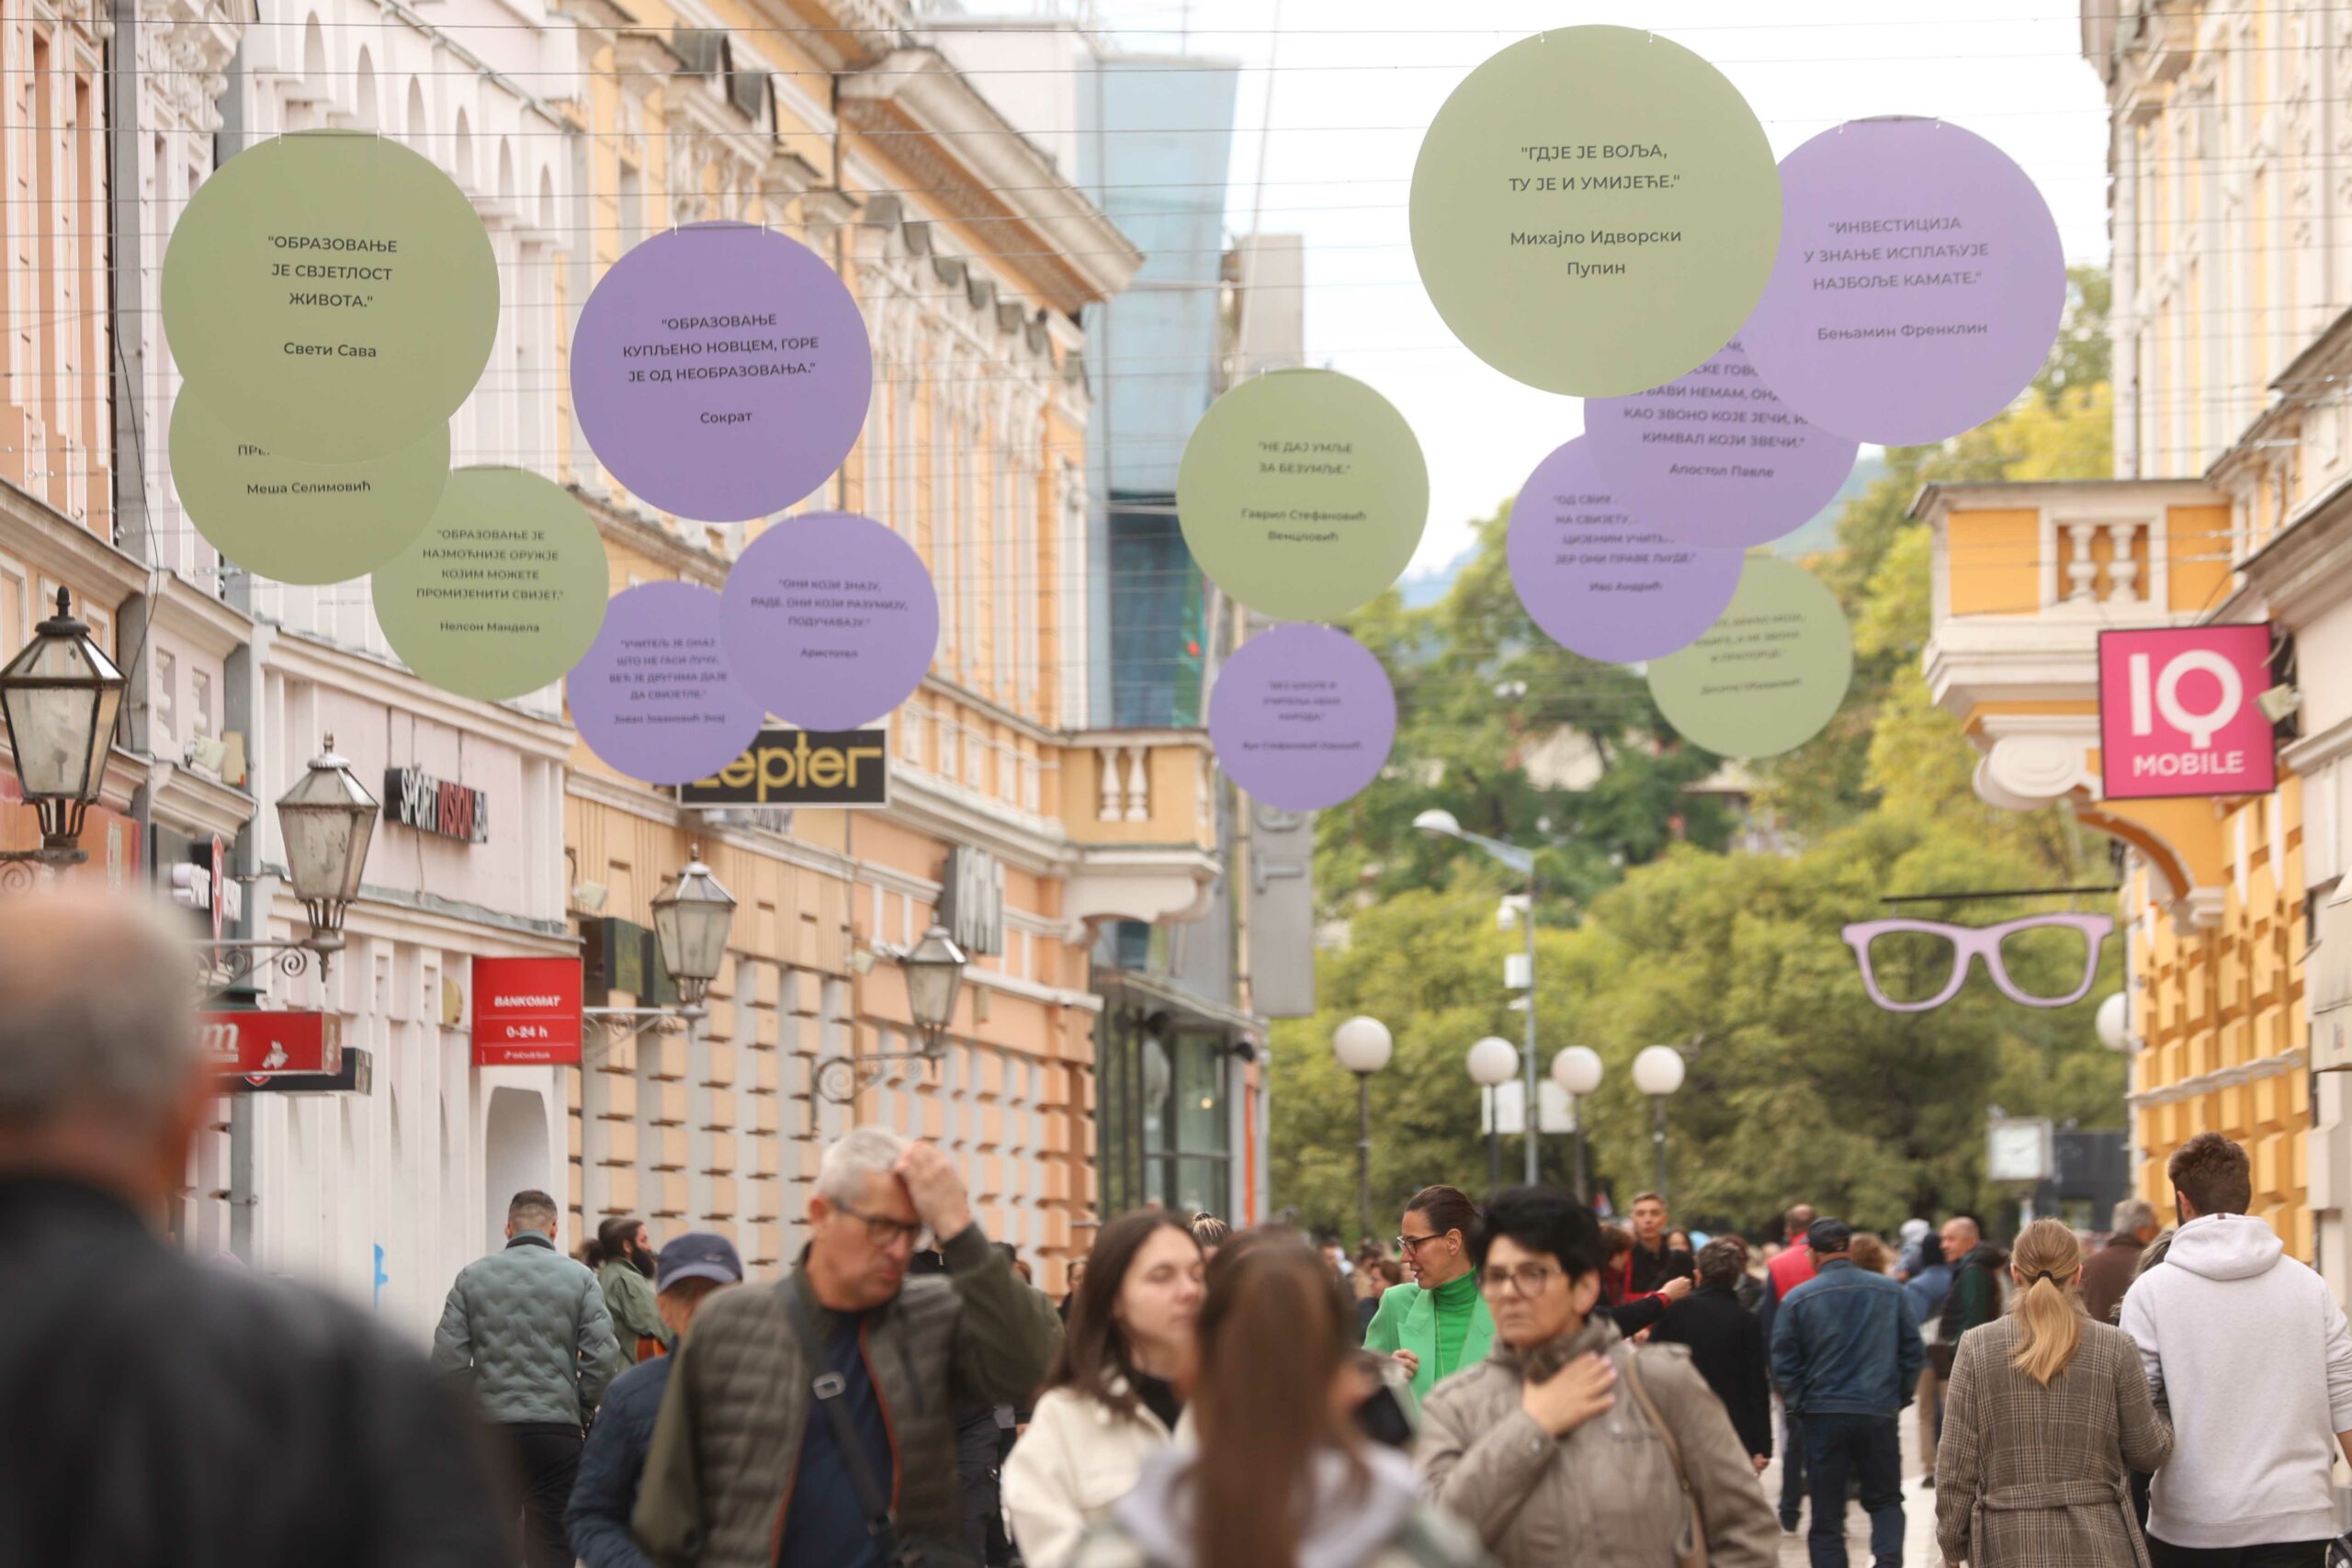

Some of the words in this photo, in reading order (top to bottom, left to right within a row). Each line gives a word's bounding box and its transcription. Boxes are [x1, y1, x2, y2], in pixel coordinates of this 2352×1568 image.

[1521, 146, 1571, 162] "ГДЈЕ
[1577, 146, 1597, 159] ЈЕ
[1603, 144, 1668, 160] ВОЉА,
[1509, 178, 1530, 191] ТУ
[1536, 177, 1556, 191] ЈЕ
[1563, 177, 1575, 190] И
[1581, 175, 1680, 189] УМИЈЕЋЕ."
[1829, 217, 1962, 234] "ИНВЕСТИЦИЈА
[267, 235, 398, 253] "ОБРАЗОВАЊЕ
[1510, 231, 1585, 248] Михајло
[1590, 231, 1681, 246] Идворски
[1804, 251, 1815, 264] У
[1819, 248, 1882, 263] ЗНАЊЕ
[1886, 243, 1989, 260] ИСПЛАЋУЈЕ
[271, 263, 290, 277] ЈЕ
[295, 264, 392, 280] СВЈЕТЛОСТ
[1567, 262, 1625, 278] Пупин
[1813, 275, 1898, 290] НАЈБОЉЕ
[1904, 271, 1982, 287] КАМАТЕ."
[288, 291, 373, 308] ЖИВОТА."
[661, 313, 777, 330] "ОБРАЗОВАЊЕ
[1817, 324, 1896, 340] Бењамин
[1900, 323, 1987, 339] Френклин
[284, 342, 333, 357] Свети
[337, 343, 377, 357] Сава
[623, 343, 702, 359] КУПЉЕНО
[707, 339, 777, 355] НОВЦЕМ,
[781, 337, 820, 351] ГОРЕ
[628, 369, 646, 382] ЈЕ
[650, 368, 673, 384] ОД
[676, 362, 816, 380] НЕОБРАЗОВАЊА."
[1690, 388, 1747, 400] НЕМАМ,
[700, 411, 752, 425] Сократ
[1623, 408, 1654, 419] КАО
[1657, 409, 1708, 422] ЗВОНО
[1712, 412, 1747, 423] КОЈЕ
[1750, 412, 1791, 425] ЈЕЧИ,
[1642, 433, 1705, 445] КИМВАЛ
[1709, 434, 1747, 446] КОЈИ
[1669, 463, 1727, 476] Апостол
[1731, 465, 1774, 478] Павле
[247, 483, 288, 495] Меша
[291, 480, 370, 493] Селимовић
[437, 529, 527, 540] "ОБРАЗОВАЊЕ
[531, 531, 545, 541] ЈЕ
[423, 549, 506, 560] НАЈМОЋНИЈЕ
[509, 550, 559, 561] ОРУЖЈЕ
[442, 570, 484, 580] КОЈИМ
[487, 570, 539, 581] МОЖЕТЕ
[416, 588, 509, 599] ПРОМИЈЕНИТИ
[512, 590, 564, 601] СВИЈЕТ."
[440, 621, 483, 632] Нелсон
[486, 621, 539, 633] Мандела
[616, 656, 640, 666] ШТО
[2129, 649, 2243, 750] IQ
[2132, 750, 2245, 777] MOBILE
[494, 995, 561, 1008] BANKOMAT
[506, 1025, 536, 1038] 0-24
[538, 1025, 548, 1038] h
